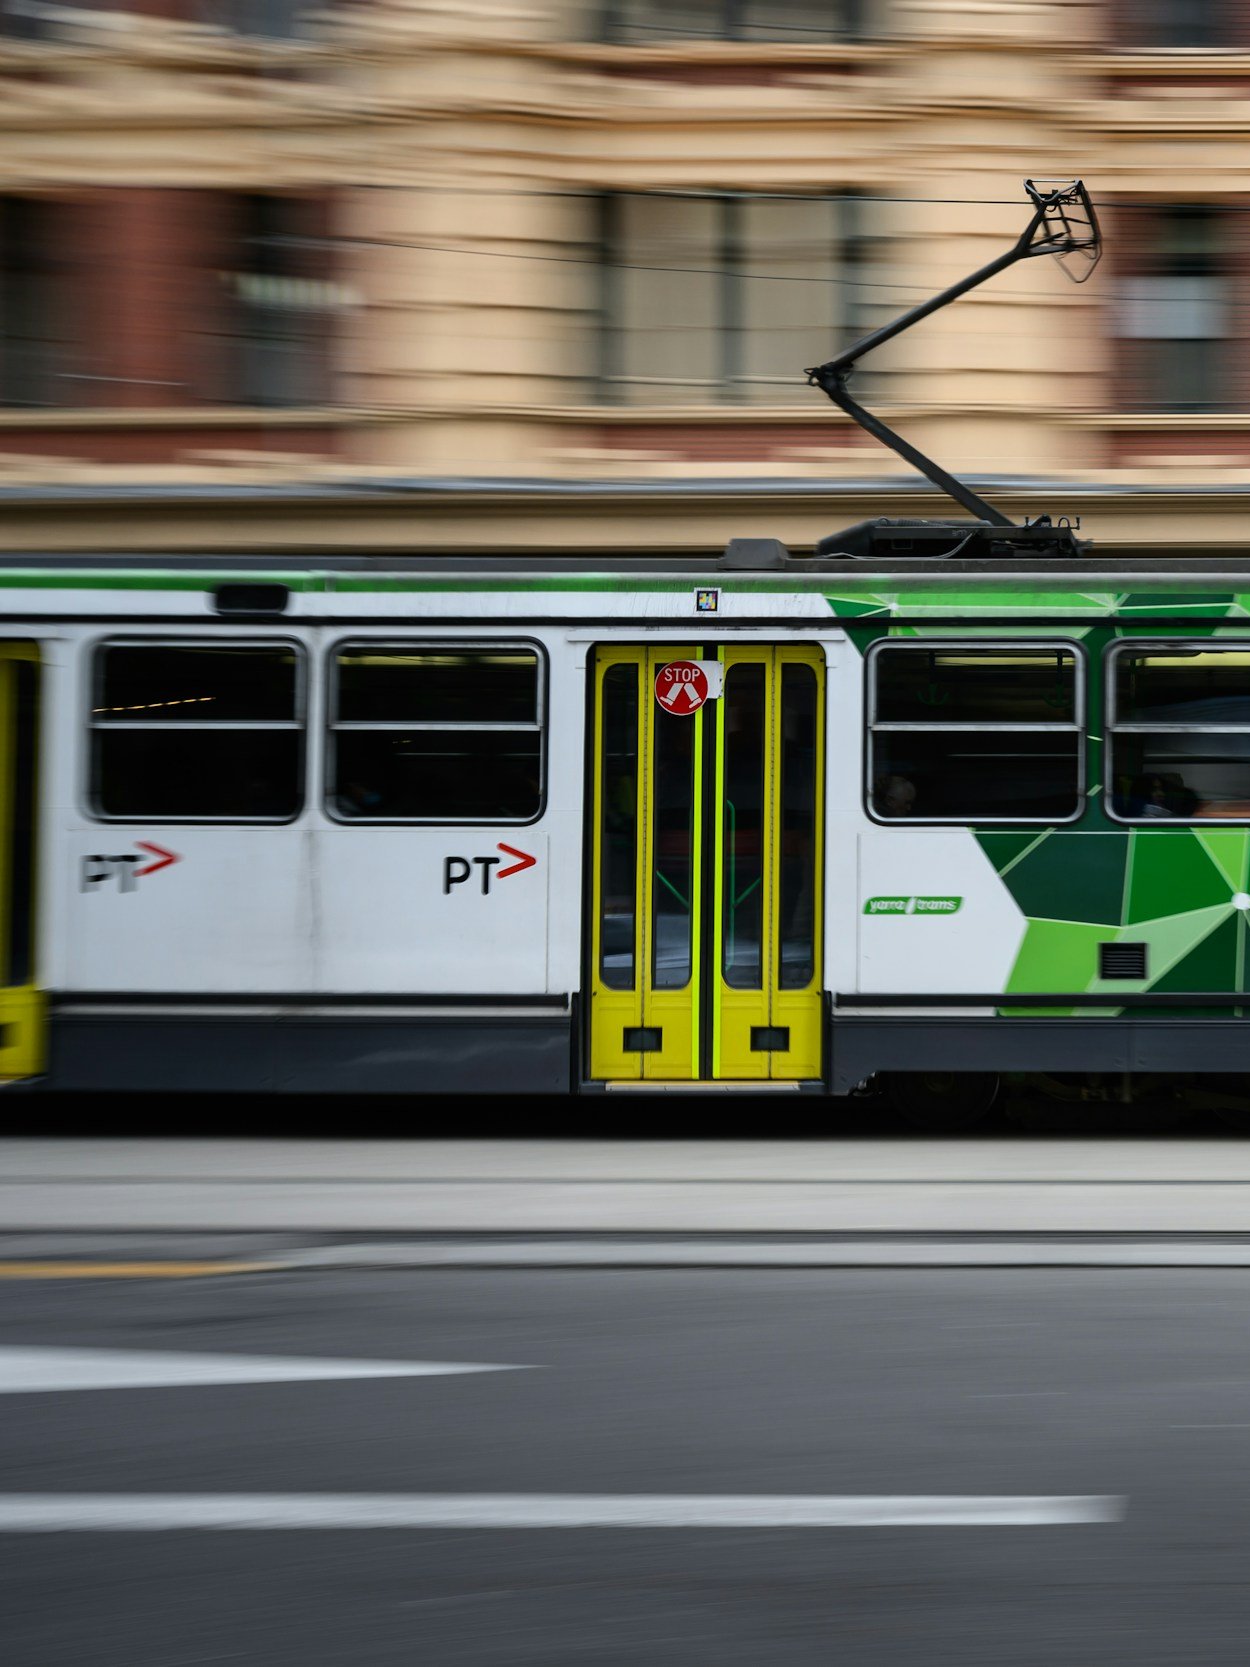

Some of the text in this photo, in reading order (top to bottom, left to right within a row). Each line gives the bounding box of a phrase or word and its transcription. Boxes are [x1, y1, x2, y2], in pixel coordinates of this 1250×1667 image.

[664, 668, 700, 682] STOP
[79, 854, 147, 894] PT
[442, 856, 500, 895] PT
